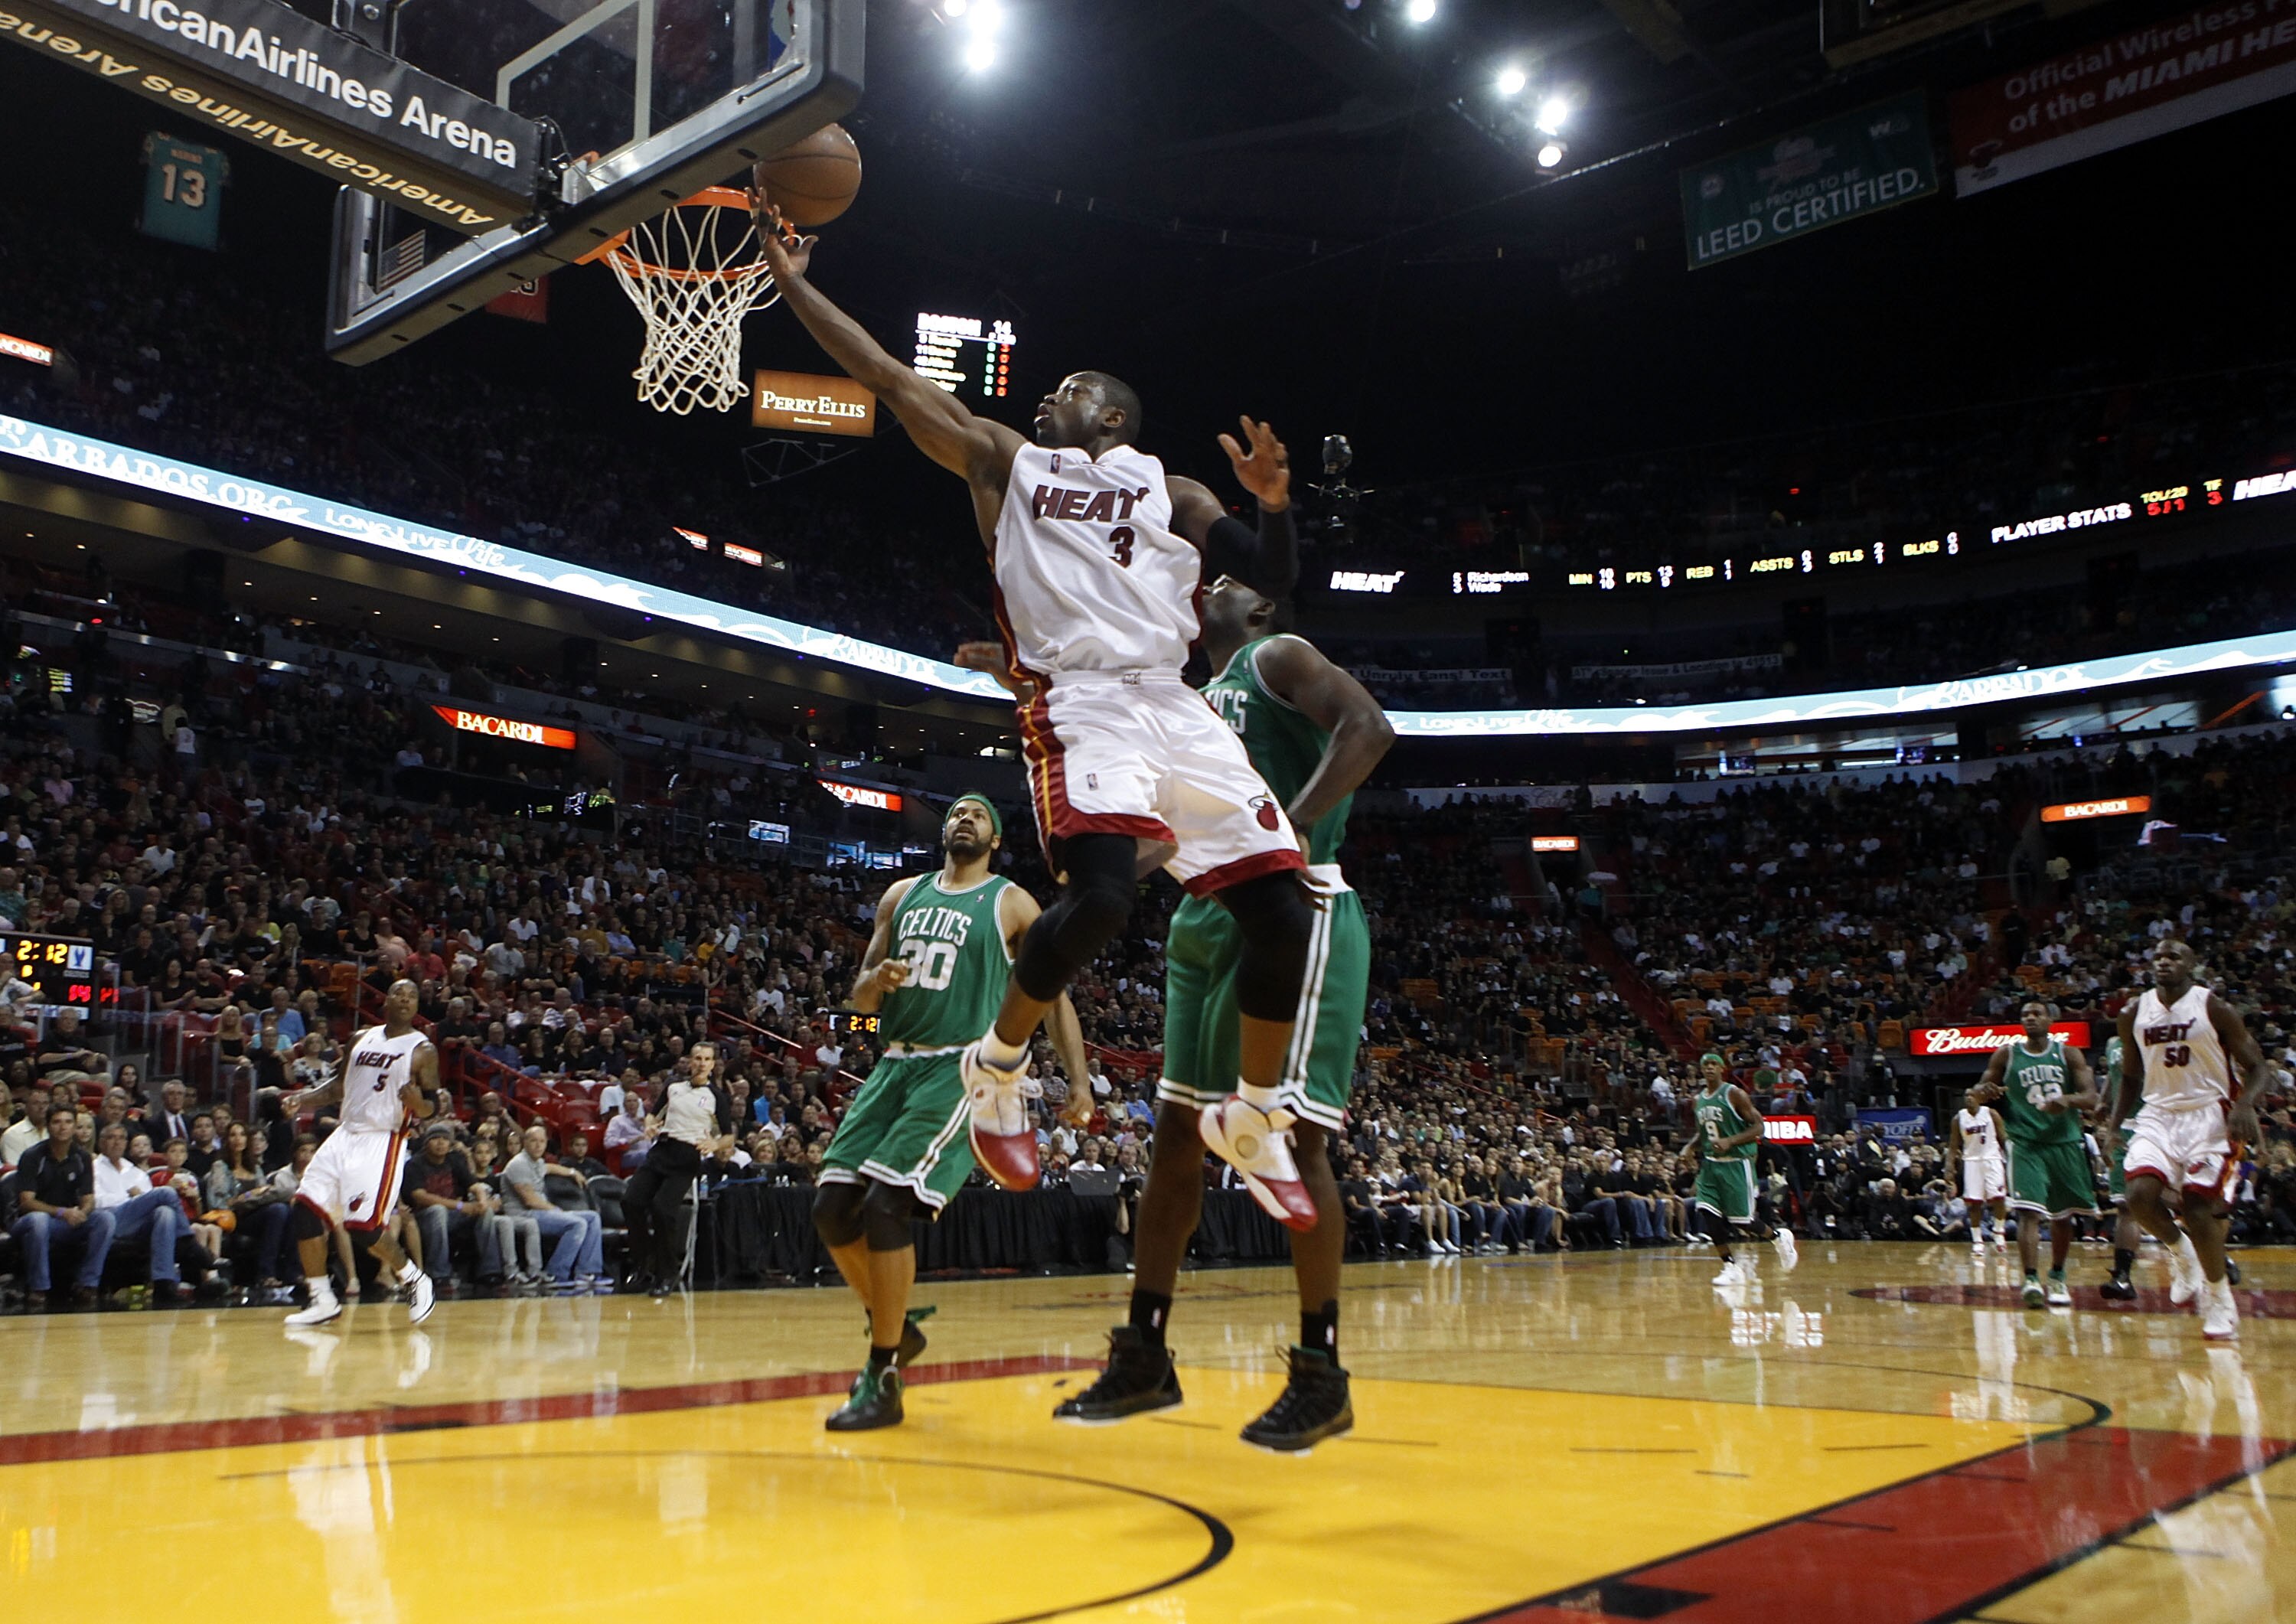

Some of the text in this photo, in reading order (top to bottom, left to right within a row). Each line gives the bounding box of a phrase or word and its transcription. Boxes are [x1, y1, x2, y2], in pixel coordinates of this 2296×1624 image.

[2005, 2, 2258, 100] Official Wireless
[2009, 103, 2040, 133] of
[2045, 90, 2095, 122] the
[2103, 40, 2236, 102] MIAMI
[400, 96, 516, 168] Arena
[140, 74, 494, 227] AmericanAirlines
[161, 163, 206, 207] 13
[1697, 168, 1926, 260] LEED CERTIFIED.
[761, 390, 866, 418] PERRY ELLIS
[1033, 484, 1150, 523] HEAT
[1991, 515, 2066, 543] PLAYER
[2067, 503, 2131, 529] STATS
[2206, 491, 2223, 505] 3
[1108, 526, 1135, 569] 3
[1467, 571, 1528, 582] Richardson
[1569, 574, 1593, 584] MIN
[1599, 568, 1614, 579] 10
[1626, 572, 1652, 583] PTS
[1658, 566, 1673, 577] 13
[1686, 566, 1714, 579] REB
[1724, 559, 1731, 569] 1
[1750, 557, 1794, 572] ASSTS
[1829, 549, 1864, 564] STLS
[1903, 540, 1939, 556] BLKS
[1330, 571, 1404, 592] HEAT
[1467, 582, 1501, 592] Wade
[1599, 579, 1615, 589] 10
[1724, 569, 1732, 580] 1
[1469, 669, 1507, 680] Text
[458, 711, 545, 744] BACARDI
[2064, 800, 2128, 817] BACARDI
[899, 906, 973, 947] CELTICS
[17, 940, 68, 964] 2:12
[899, 939, 958, 992] 30
[850, 1015, 877, 1032] 2:12
[2144, 1016, 2197, 1046] HEAT
[355, 1051, 405, 1069] HEAT
[2164, 1045, 2191, 1068] 50
[373, 1074, 390, 1091] 5
[2018, 1065, 2065, 1088] CELTICS
[1705, 1120, 1720, 1140] 9
